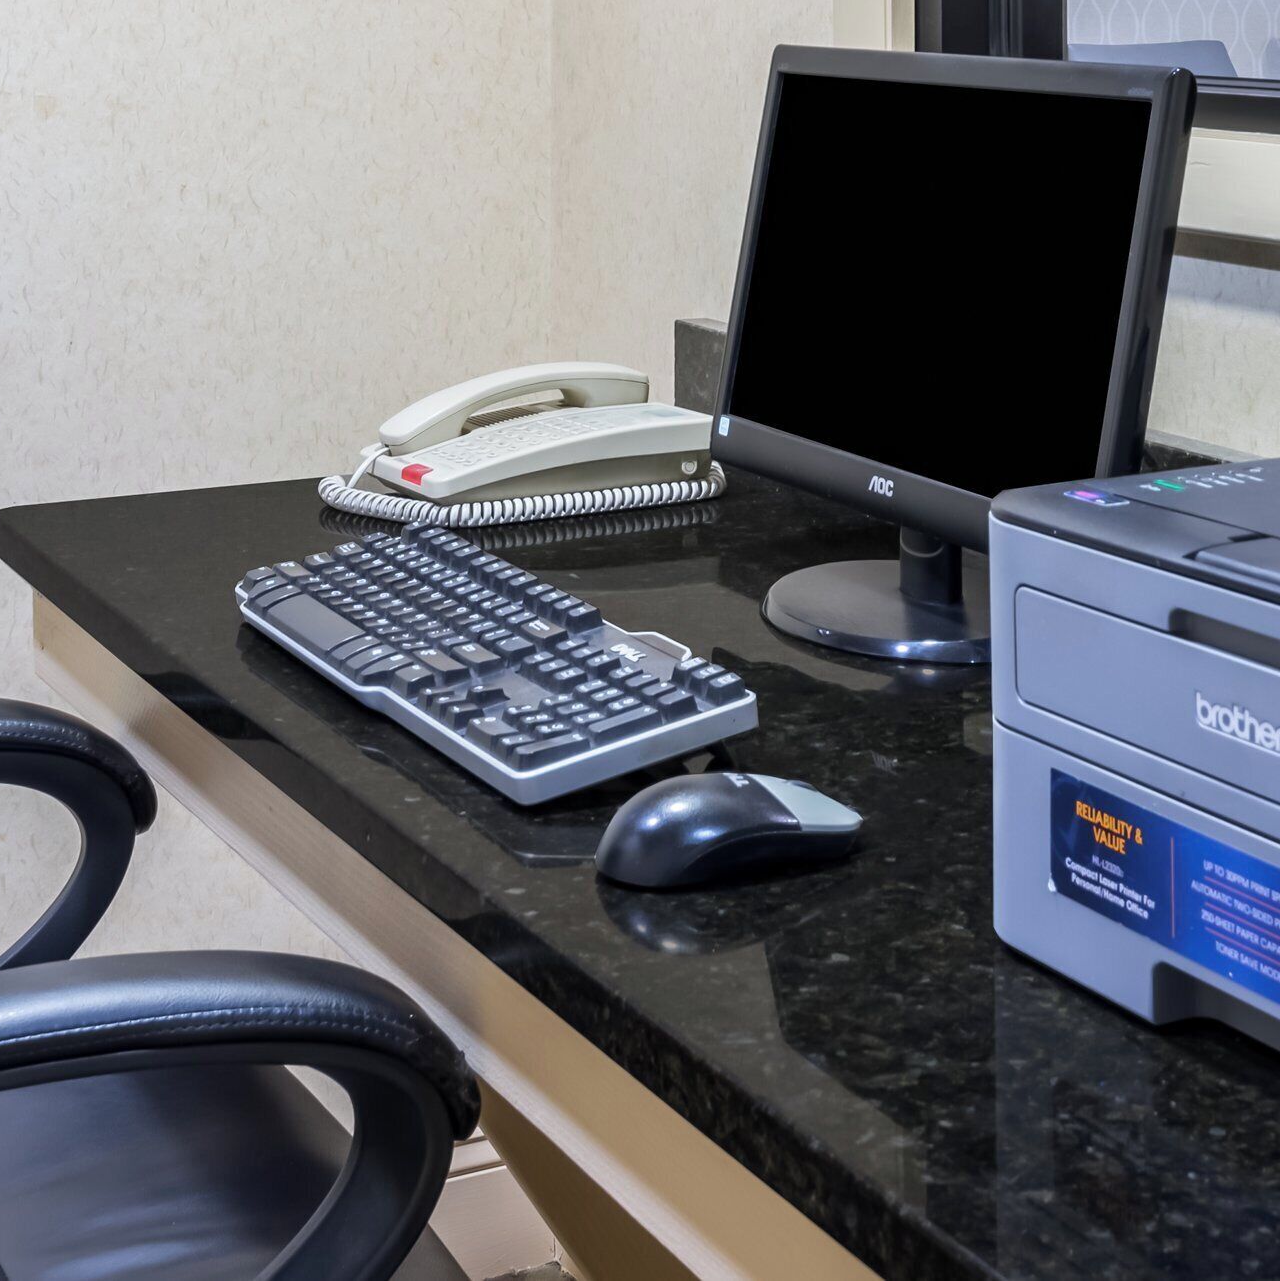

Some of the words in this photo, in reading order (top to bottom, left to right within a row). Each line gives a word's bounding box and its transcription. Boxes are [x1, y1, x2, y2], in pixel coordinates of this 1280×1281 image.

[868, 475, 894, 497] AOC
[610, 644, 647, 663] DELL
[1075, 800, 1133, 839] RELIABILITY
[1134, 827, 1143, 845] &
[1093, 825, 1126, 855] VALUE
[1065, 856, 1098, 881] Compact
[1099, 873, 1118, 891] Laser
[1119, 883, 1142, 903] Printer
[1143, 894, 1155, 910] For
[1203, 859, 1214, 872] UP
[1214, 863, 1225, 878] TO
[1071, 872, 1125, 908] Personal/Home
[1126, 900, 1149, 920] Office
[1191, 879, 1233, 907] AUTOMATIC
[1236, 924, 1259, 946] PAPER
[1215, 940, 1239, 961] TONER
[1240, 952, 1260, 972] SAVE
